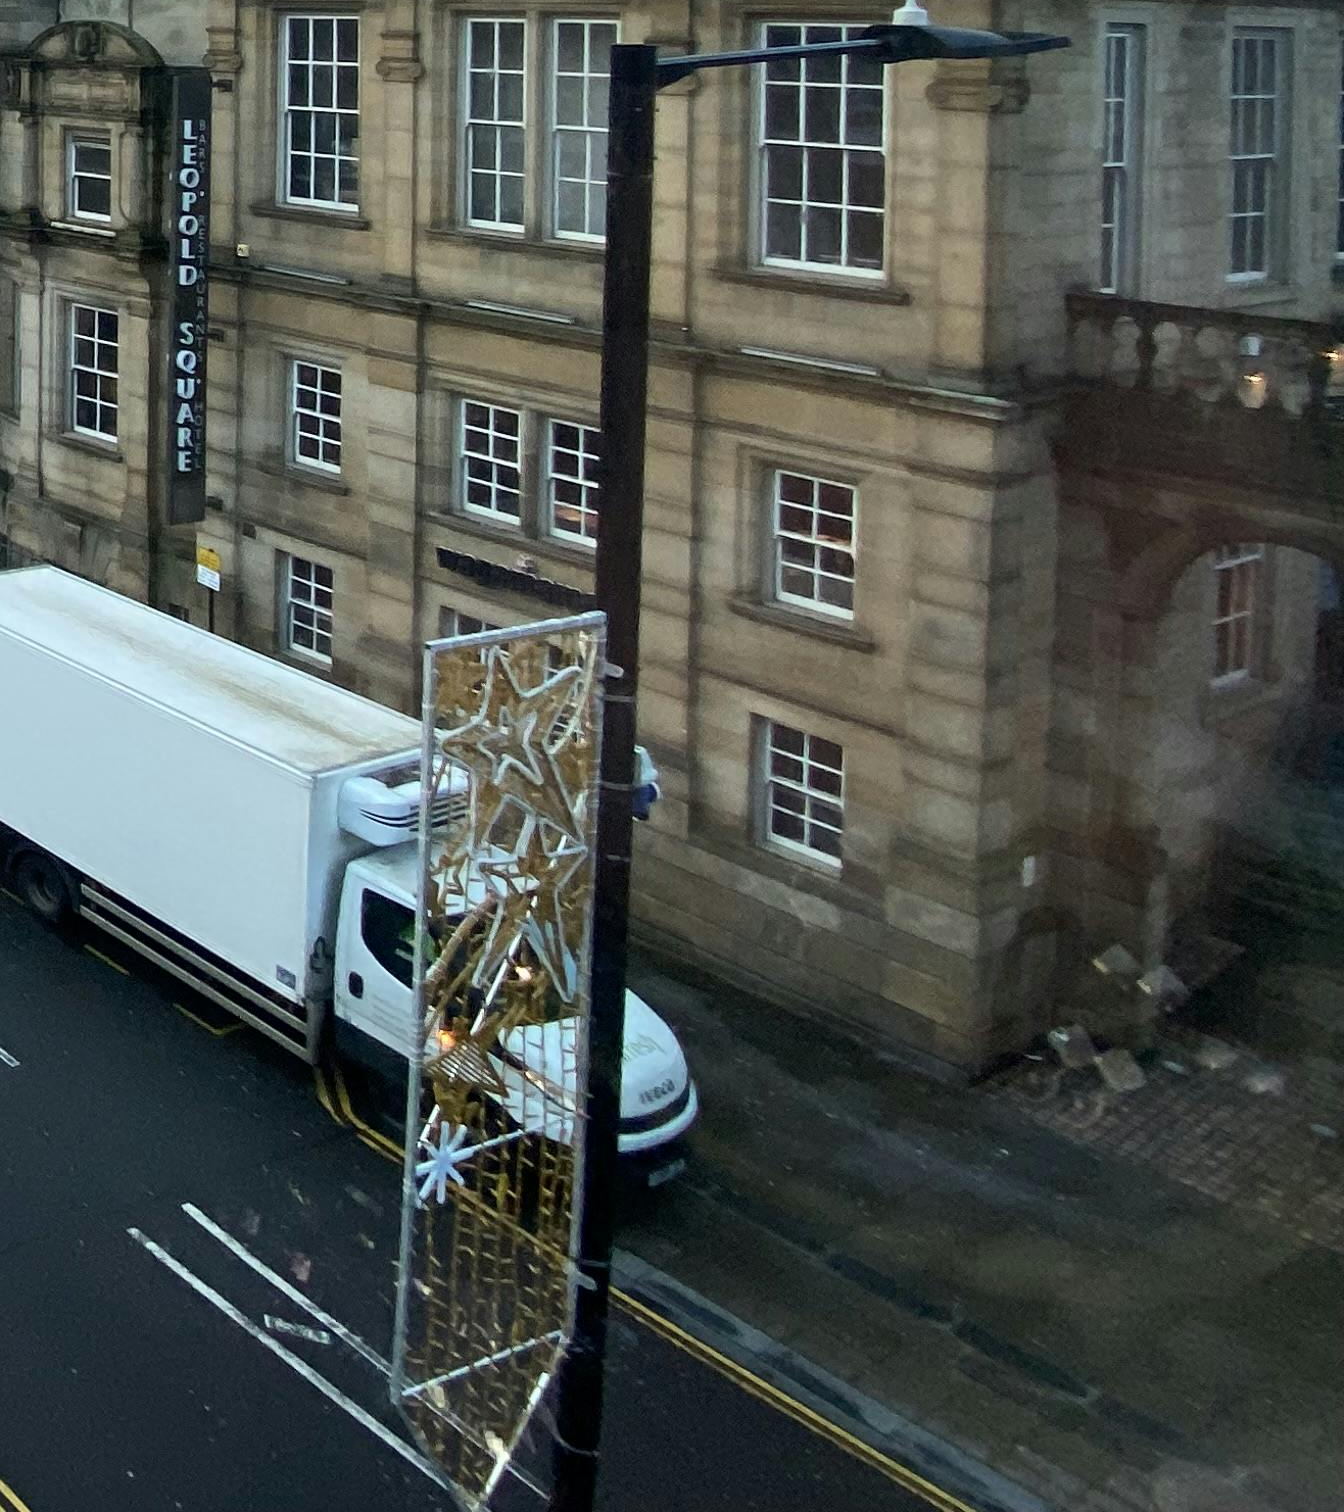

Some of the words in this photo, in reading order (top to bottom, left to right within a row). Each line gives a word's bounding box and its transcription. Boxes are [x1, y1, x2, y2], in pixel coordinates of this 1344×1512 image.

[178, 120, 200, 286] LEOPOLD
[198, 119, 207, 173] BARS
[194, 214, 206, 363] RESTAURANTS
[175, 321, 197, 473] SQUARE
[193, 400, 204, 470] HOTEL
